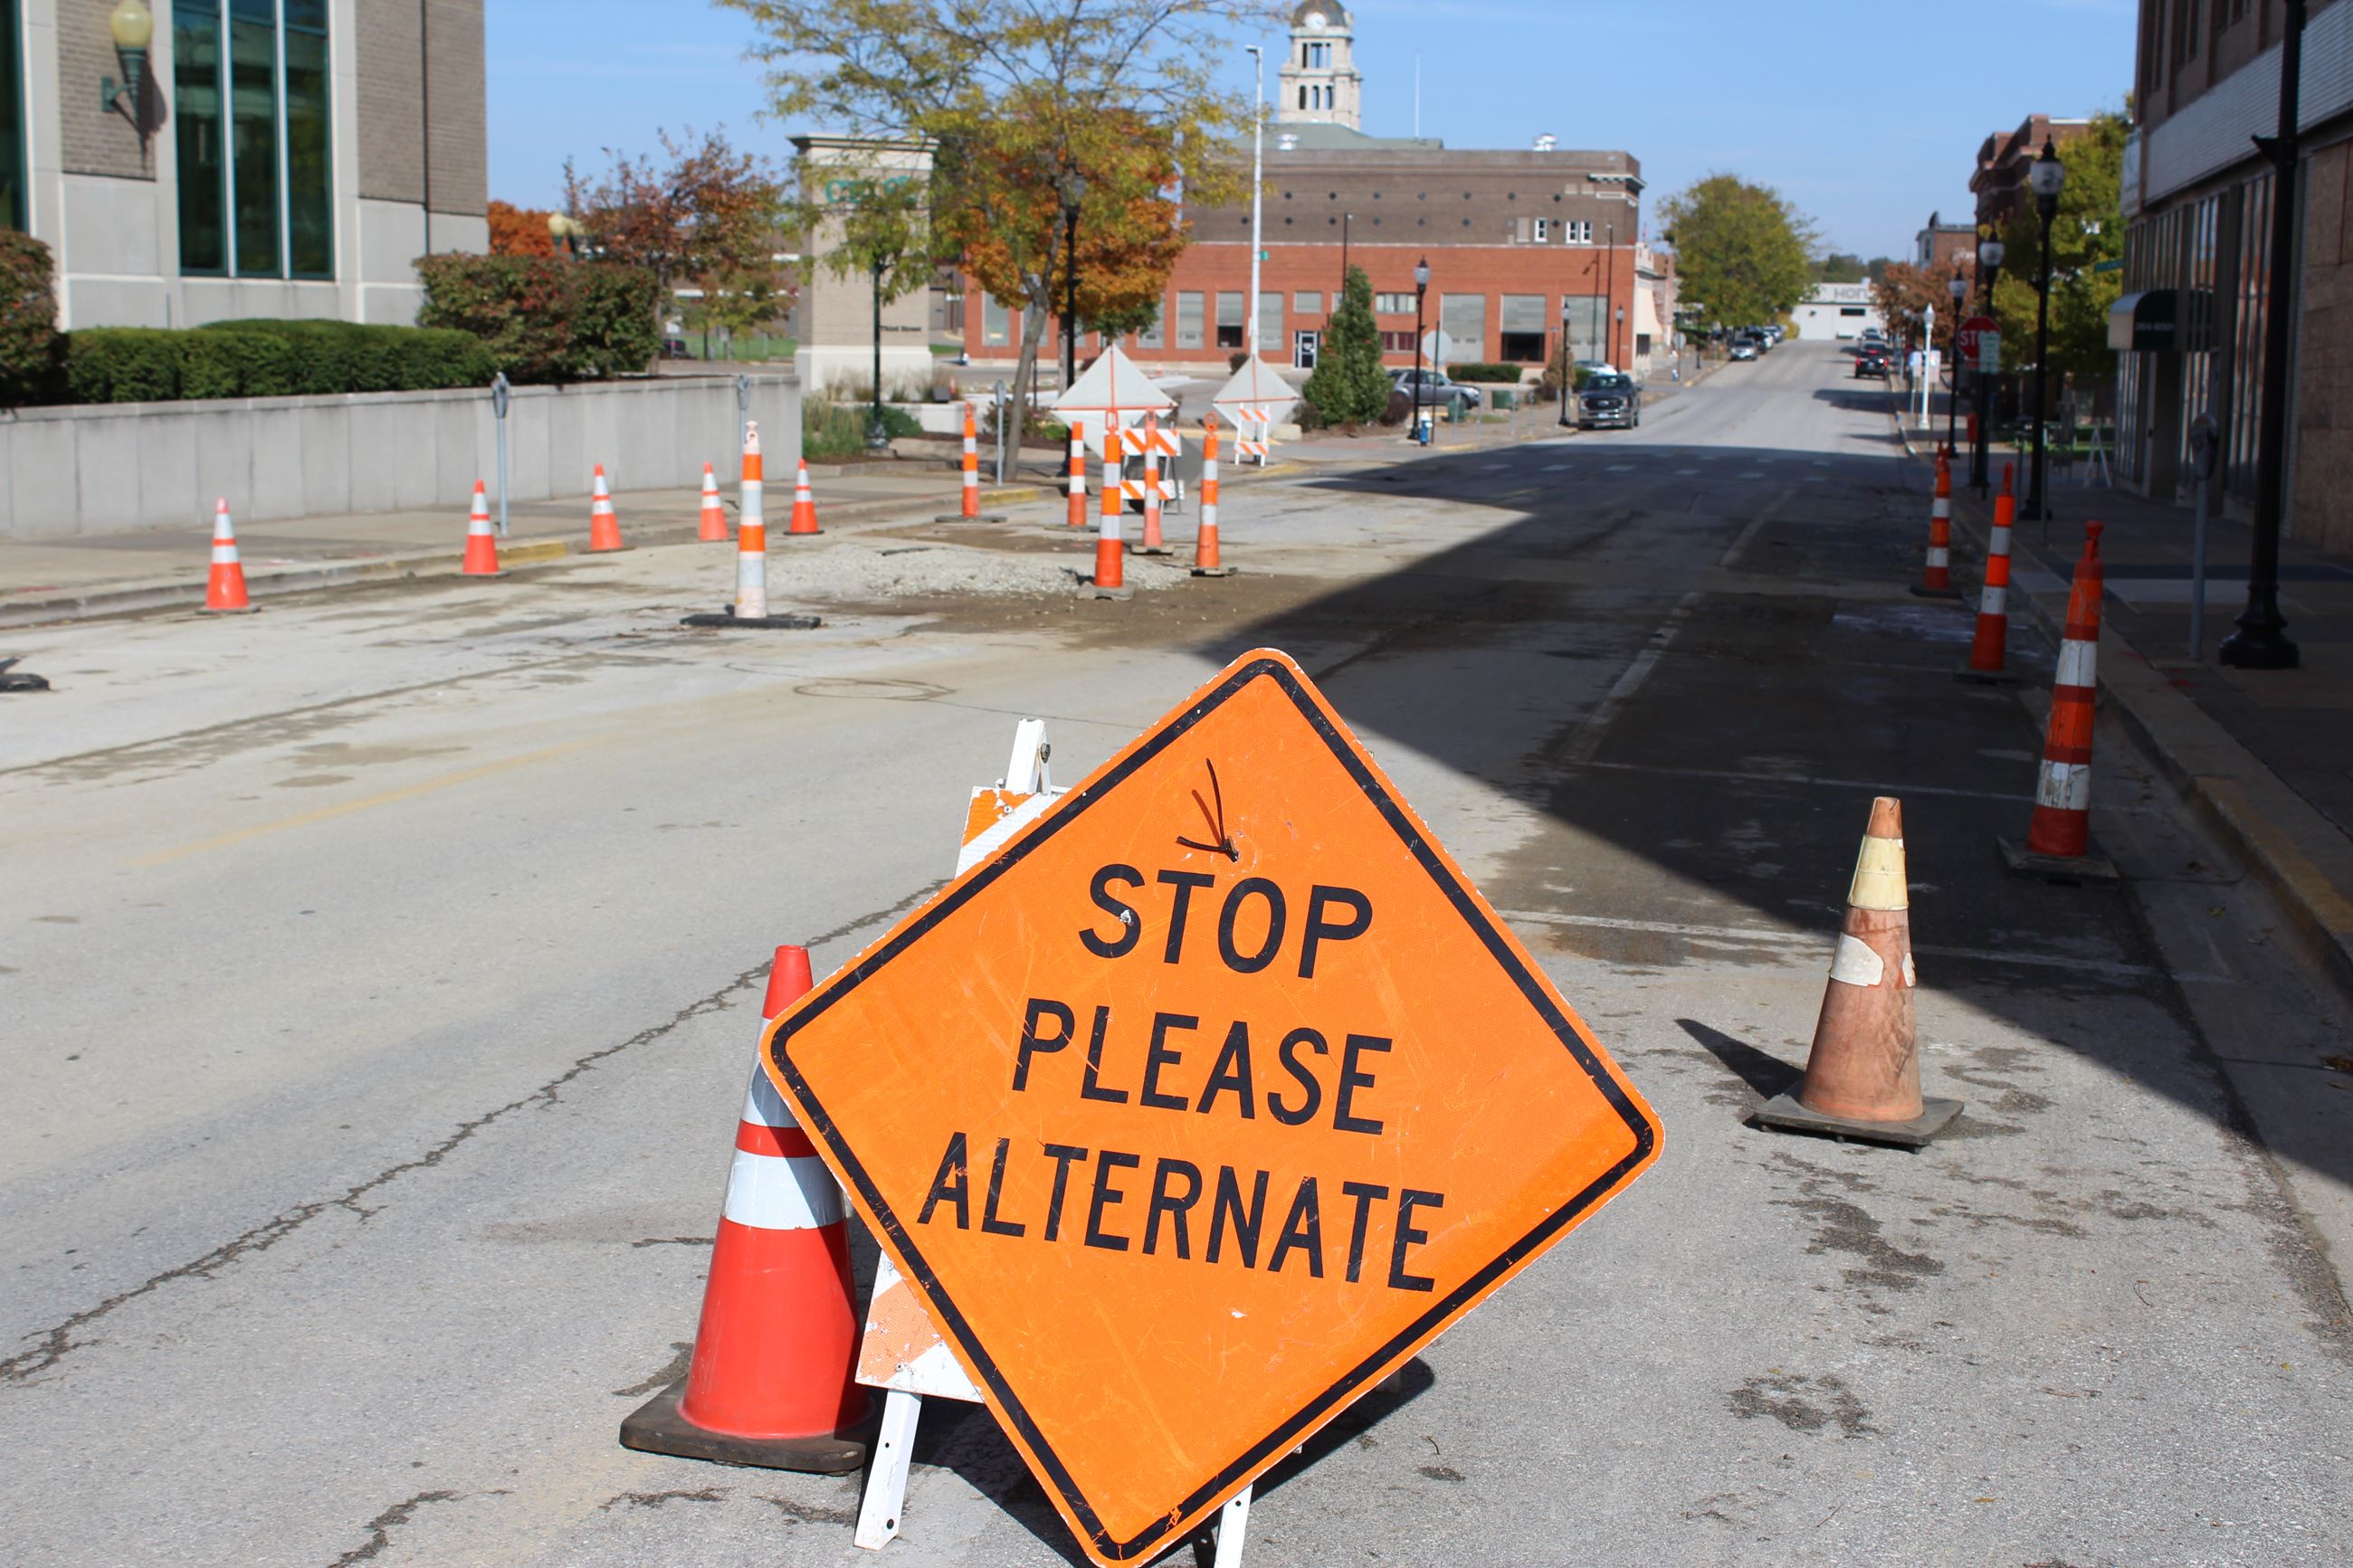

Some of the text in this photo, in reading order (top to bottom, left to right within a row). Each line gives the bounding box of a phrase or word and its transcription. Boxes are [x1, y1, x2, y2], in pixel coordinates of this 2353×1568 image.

[1080, 864, 1373, 979] STOP
[1013, 999, 1392, 1135] PLEASE
[917, 1133, 1444, 1292] ALTERNATE
